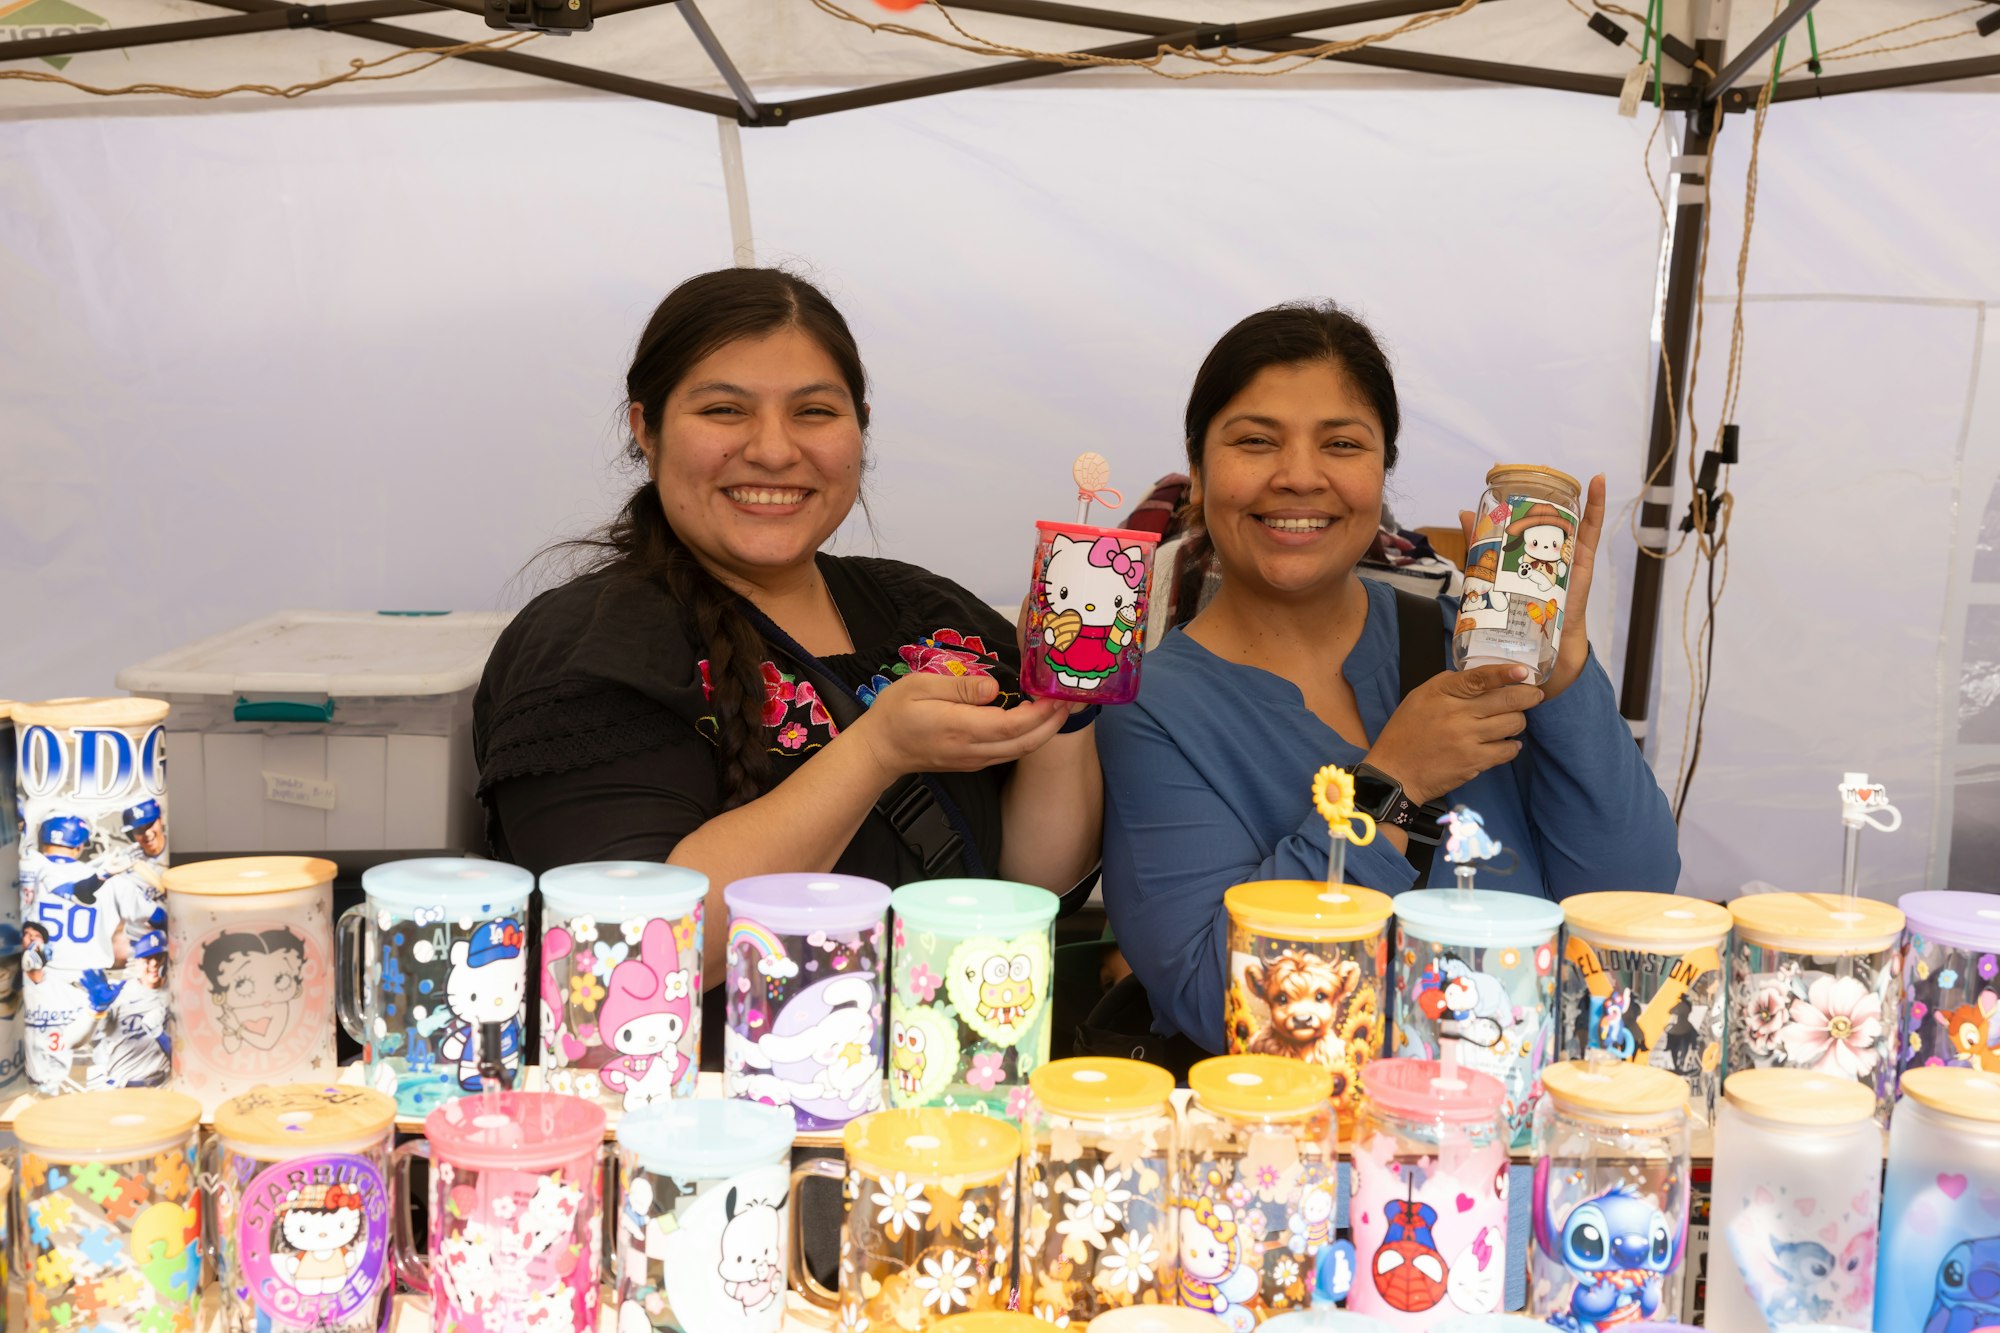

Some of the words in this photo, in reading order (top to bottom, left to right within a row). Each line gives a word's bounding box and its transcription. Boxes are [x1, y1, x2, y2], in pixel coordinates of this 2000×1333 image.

[39, 901, 98, 944] 50
[382, 944, 405, 994] LA
[48, 1032, 65, 1052] 3
[406, 1026, 436, 1074] LA
[247, 1163, 386, 1233] STARBUCKS
[260, 1269, 373, 1319] COFFEE
